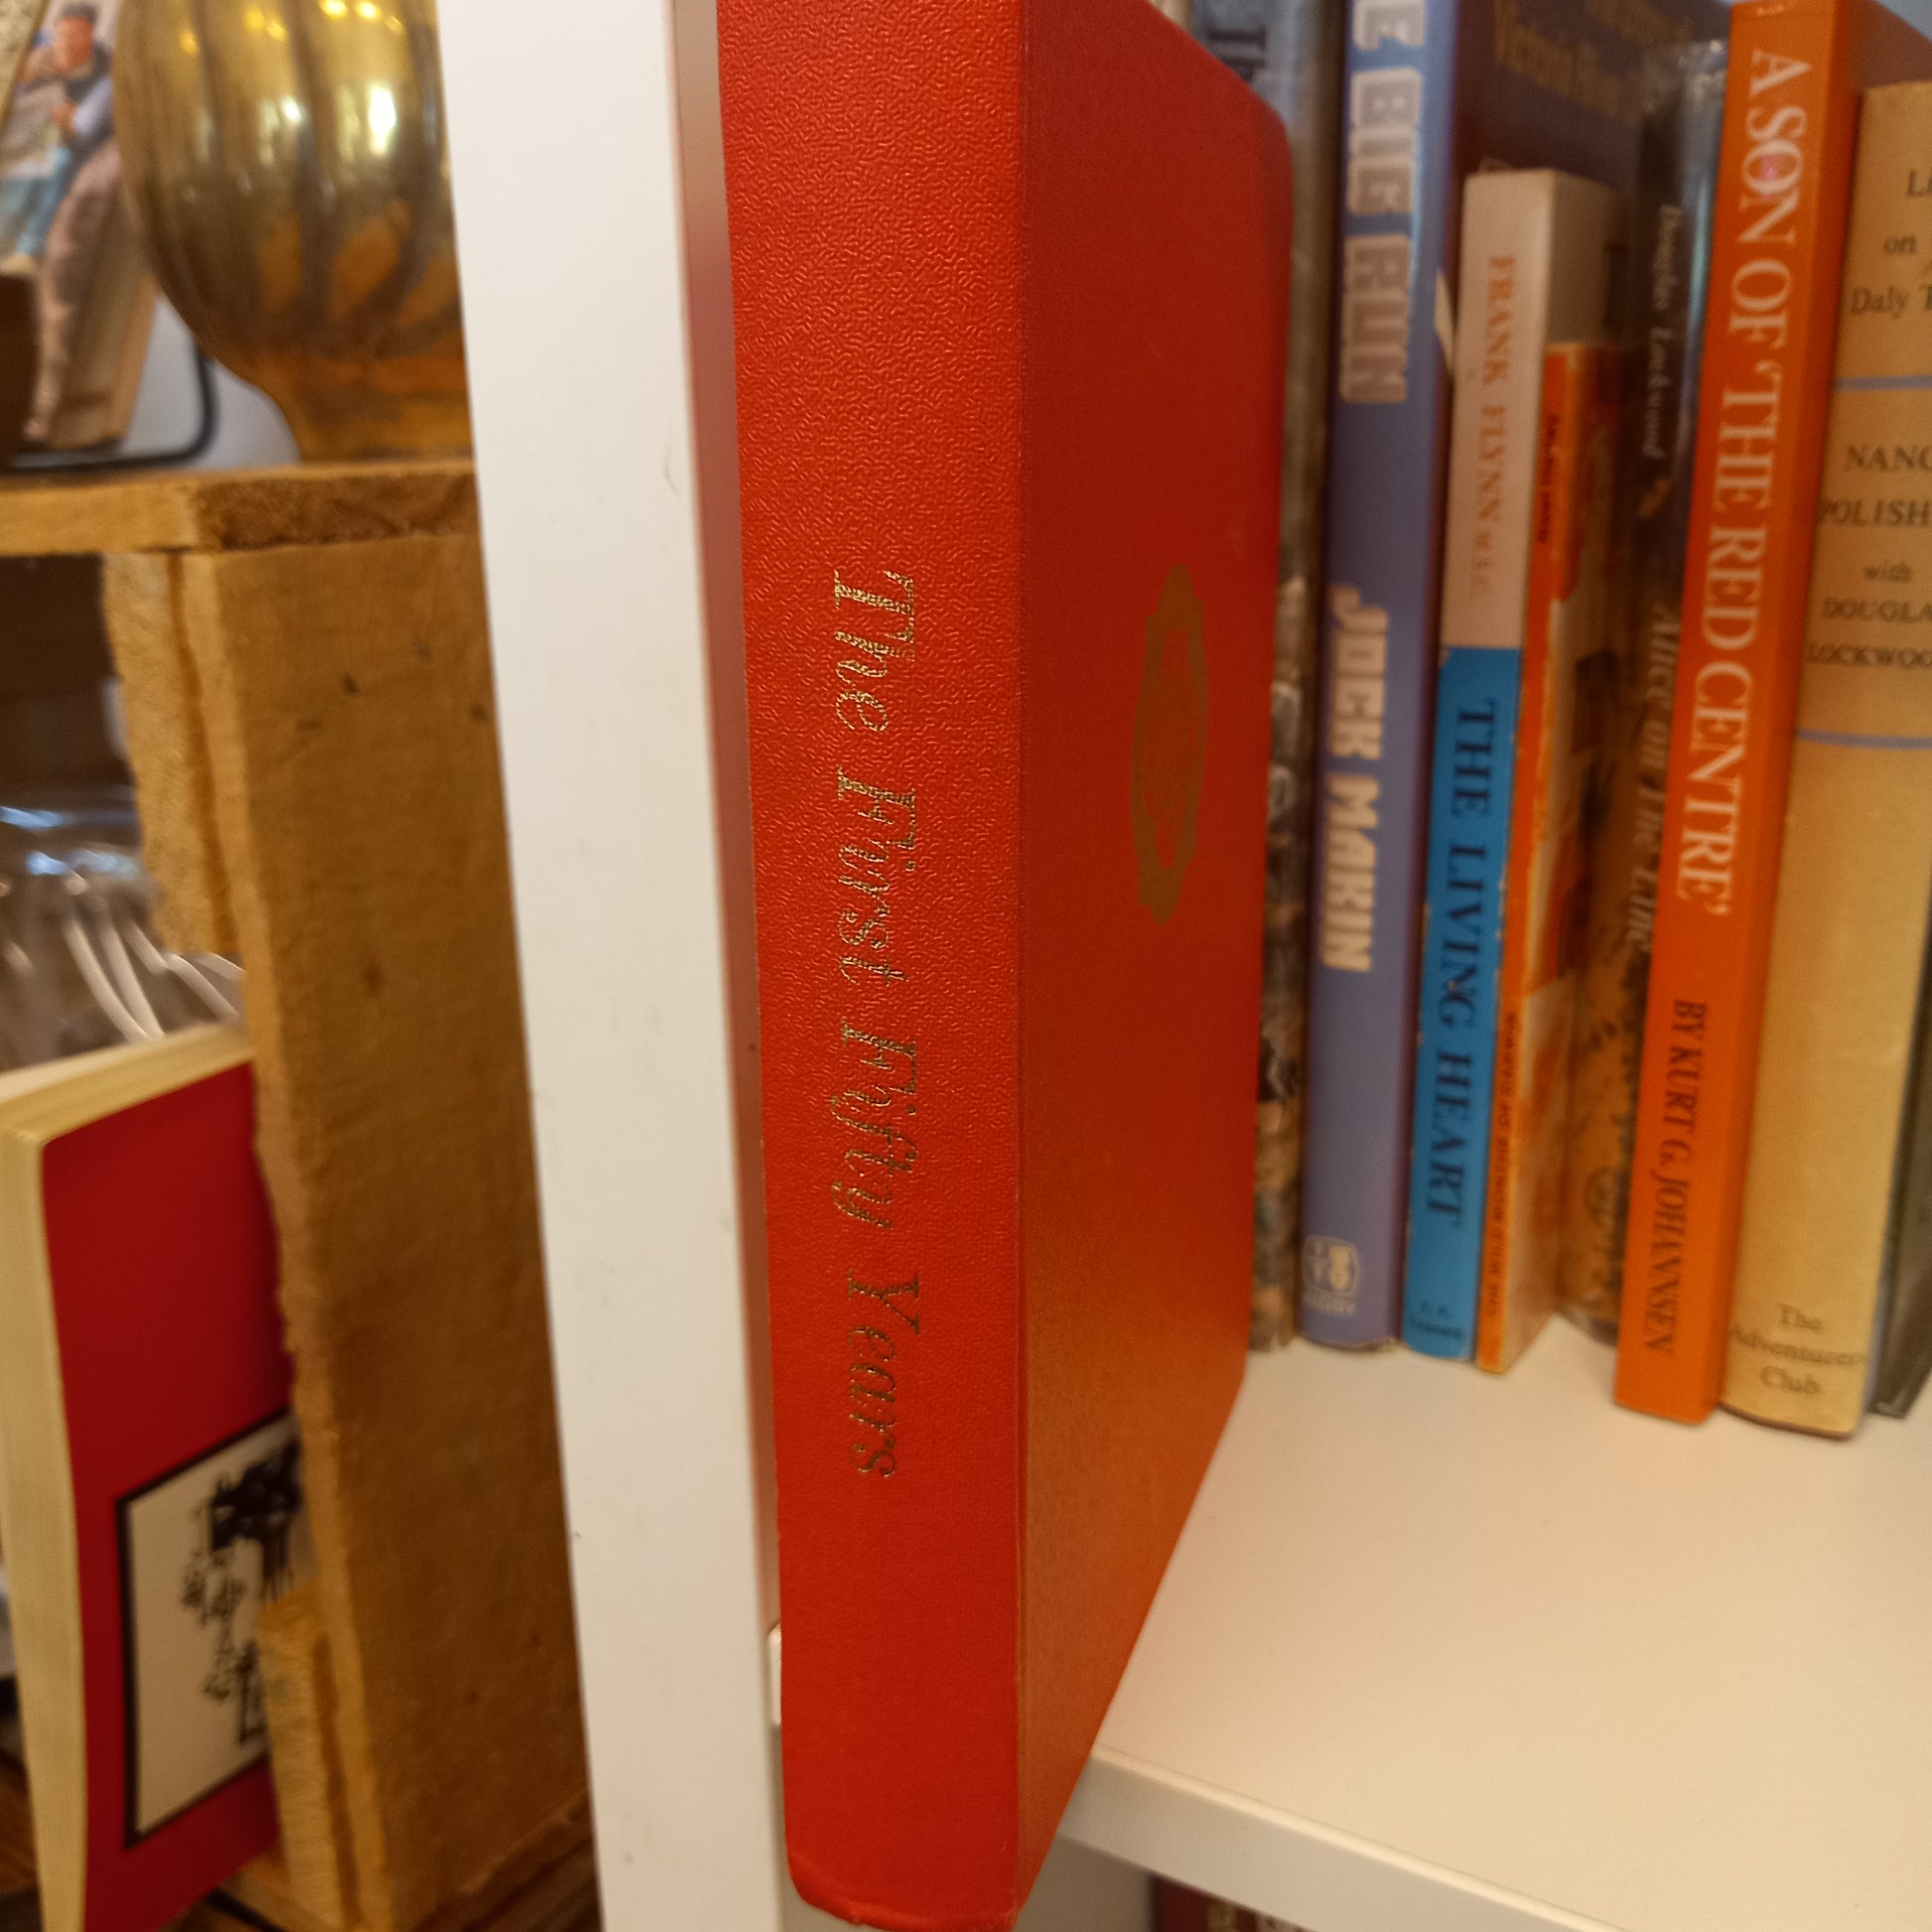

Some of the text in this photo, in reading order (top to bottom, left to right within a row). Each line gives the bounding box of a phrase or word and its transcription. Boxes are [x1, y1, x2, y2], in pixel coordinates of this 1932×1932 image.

[1748, 49, 1812, 97] A
[1347, 67, 1423, 216] BIG
[1737, 104, 1809, 245] SON
[1728, 259, 1793, 351] OF
[1850, 284, 1910, 319] Daly
[1883, 235, 1917, 255] on
[1338, 232, 1412, 404] RUN
[1480, 256, 1516, 387] FRANK
[1474, 403, 1508, 522] FLYNN
[1700, 527, 1767, 650] RED
[1326, 583, 1388, 760] JOCK
[829, 569, 920, 1479] The First Fifty Years
[1426, 697, 1497, 1229] THE LIVING HEART
[1671, 999, 1708, 1039] BY
[1662, 1045, 1704, 1135] KURT
[1642, 1166, 1691, 1358] JOHANNSEN
